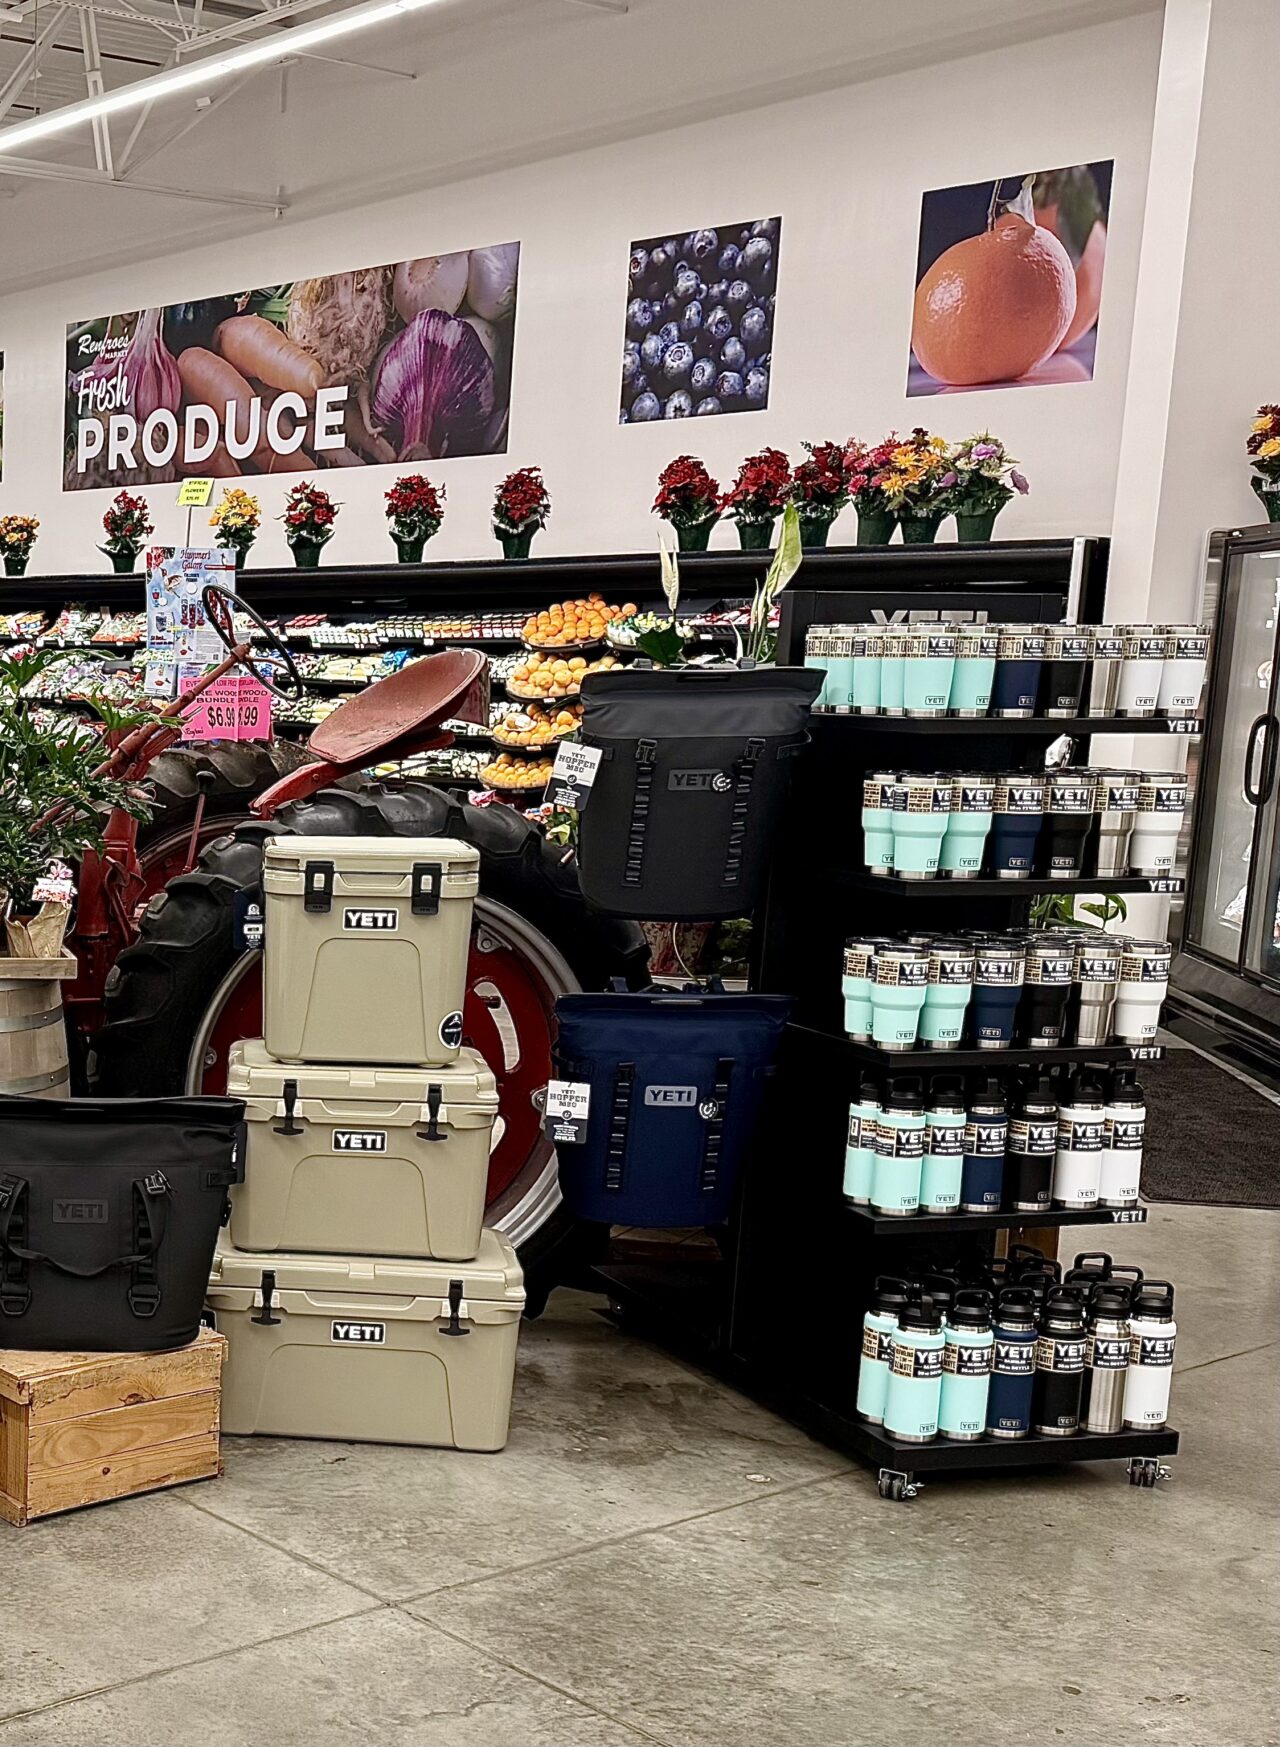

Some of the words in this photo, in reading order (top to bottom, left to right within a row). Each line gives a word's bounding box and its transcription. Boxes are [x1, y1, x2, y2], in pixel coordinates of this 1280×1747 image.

[77, 327, 132, 359] Renfroe's
[77, 362, 131, 415] Fresh
[77, 385, 348, 474] PRODUCE
[1179, 638, 1205, 649] YETI
[1167, 720, 1199, 732] YETI
[558, 754, 596, 770] HOPPER
[1012, 789, 1043, 800] YETI
[1054, 788, 1088, 800] YETI
[1149, 880, 1180, 892] YETI
[346, 911, 395, 928] YETI
[979, 961, 1013, 973] YETI
[1083, 959, 1116, 971] YETI
[898, 1031, 914, 1039] YETI
[1130, 1047, 1161, 1059] YETI
[549, 1093, 588, 1104] HOPPER
[650, 1090, 692, 1103] YETI
[933, 1129, 965, 1141] YETI
[979, 1128, 1007, 1140] YETI
[336, 1133, 383, 1149] YETI
[56, 1203, 105, 1220] YETI
[1112, 1211, 1142, 1223] YETI
[334, 1324, 381, 1340] YETI
[998, 1345, 1033, 1358] YETI
[1096, 1341, 1130, 1354] YETI
[1143, 1339, 1174, 1352] YETI
[961, 1349, 992, 1361] YETI
